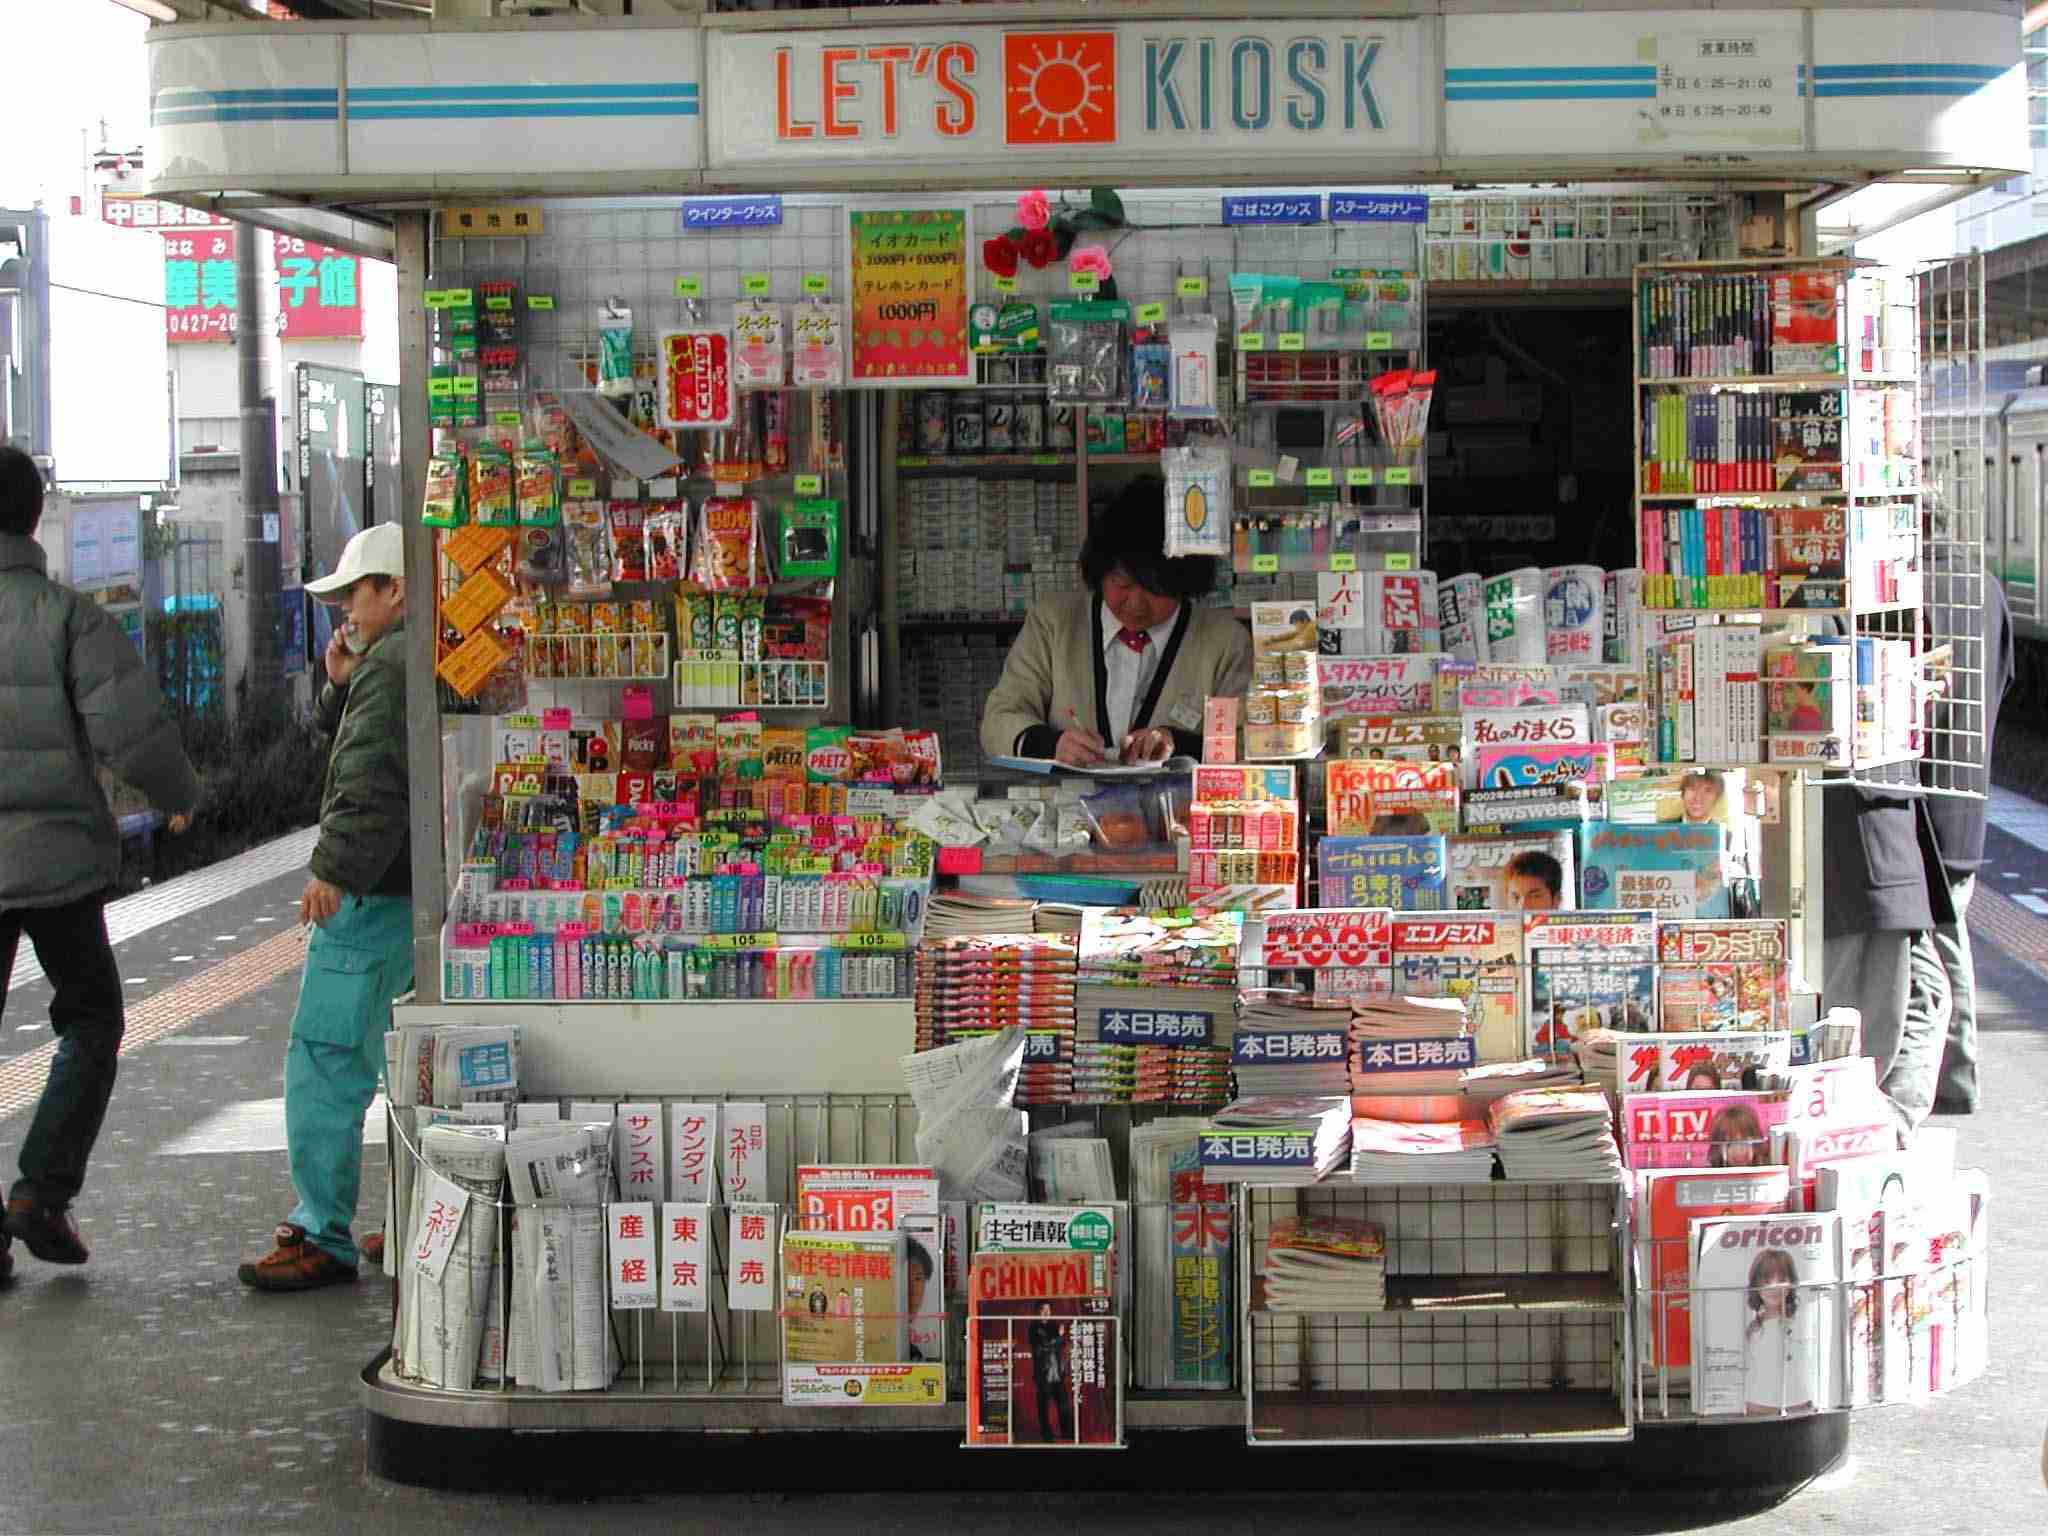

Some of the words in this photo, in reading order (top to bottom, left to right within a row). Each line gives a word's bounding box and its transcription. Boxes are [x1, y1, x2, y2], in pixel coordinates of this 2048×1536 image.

[776, 45, 976, 138] LET'S
[1144, 36, 1384, 132] KIOSK
[688, 205, 778, 222] ウインターグッズ
[1231, 201, 1312, 217] たばこグッズ
[1334, 202, 1423, 214] ステーショナリー
[870, 231, 951, 248] イオカード
[863, 279, 954, 292] テレホンカード
[878, 302, 936, 321] 1000円
[699, 650, 722, 661] 105
[1473, 715, 1576, 744] 私のかまくら
[766, 751, 802, 767] PRETZ
[810, 753, 849, 769] PRETZ
[471, 924, 497, 936] 120
[730, 935, 757, 946] 105
[858, 935, 885, 946] 105
[1403, 923, 1492, 944] エコノミスト
[1103, 1010, 1206, 1037] 本日発売
[1239, 1033, 1342, 1058] 本日発売
[1366, 1041, 1472, 1066] 本日発売
[1667, 1109, 1709, 1136] TV
[628, 1114, 656, 1184] サンスポ
[750, 1124, 762, 1150] 日刊
[1203, 1135, 1309, 1160] 本日発売
[680, 1115, 705, 1186] ゲンダイ
[730, 1127, 748, 1193] スポーツ
[984, 1218, 1067, 1243] 住宅情報
[1719, 1224, 1824, 1250] oricon
[618, 1214, 647, 1284] 産経
[672, 1216, 698, 1287] 東京
[740, 1215, 766, 1286] 読売
[799, 1251, 892, 1281] 住宅情報
[978, 1261, 1089, 1298] CHINTAI
